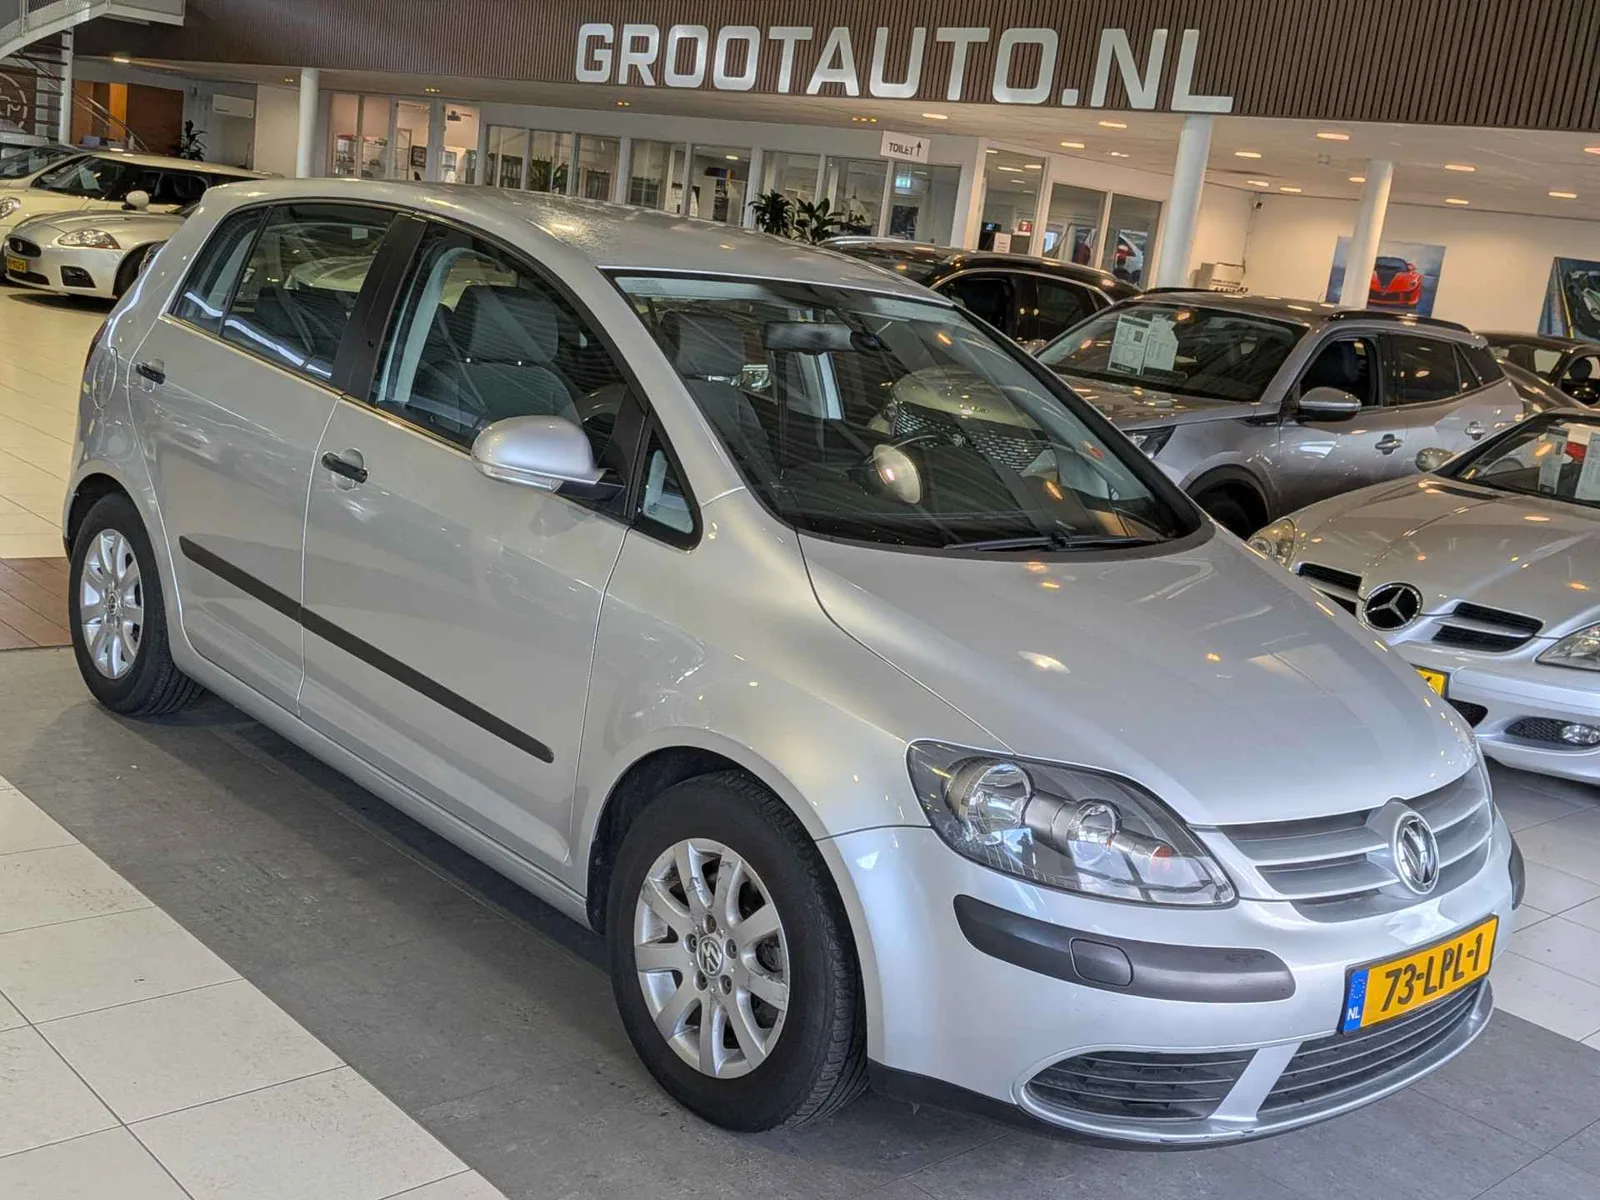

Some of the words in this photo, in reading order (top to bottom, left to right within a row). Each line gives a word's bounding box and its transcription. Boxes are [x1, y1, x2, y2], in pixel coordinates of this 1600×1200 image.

[575, 23, 1234, 113] GROOTAUTO.NL
[889, 142, 914, 156] TOILET
[1380, 932, 1484, 1013] 73-LPL-1
[1346, 1006, 1361, 1021] NL
